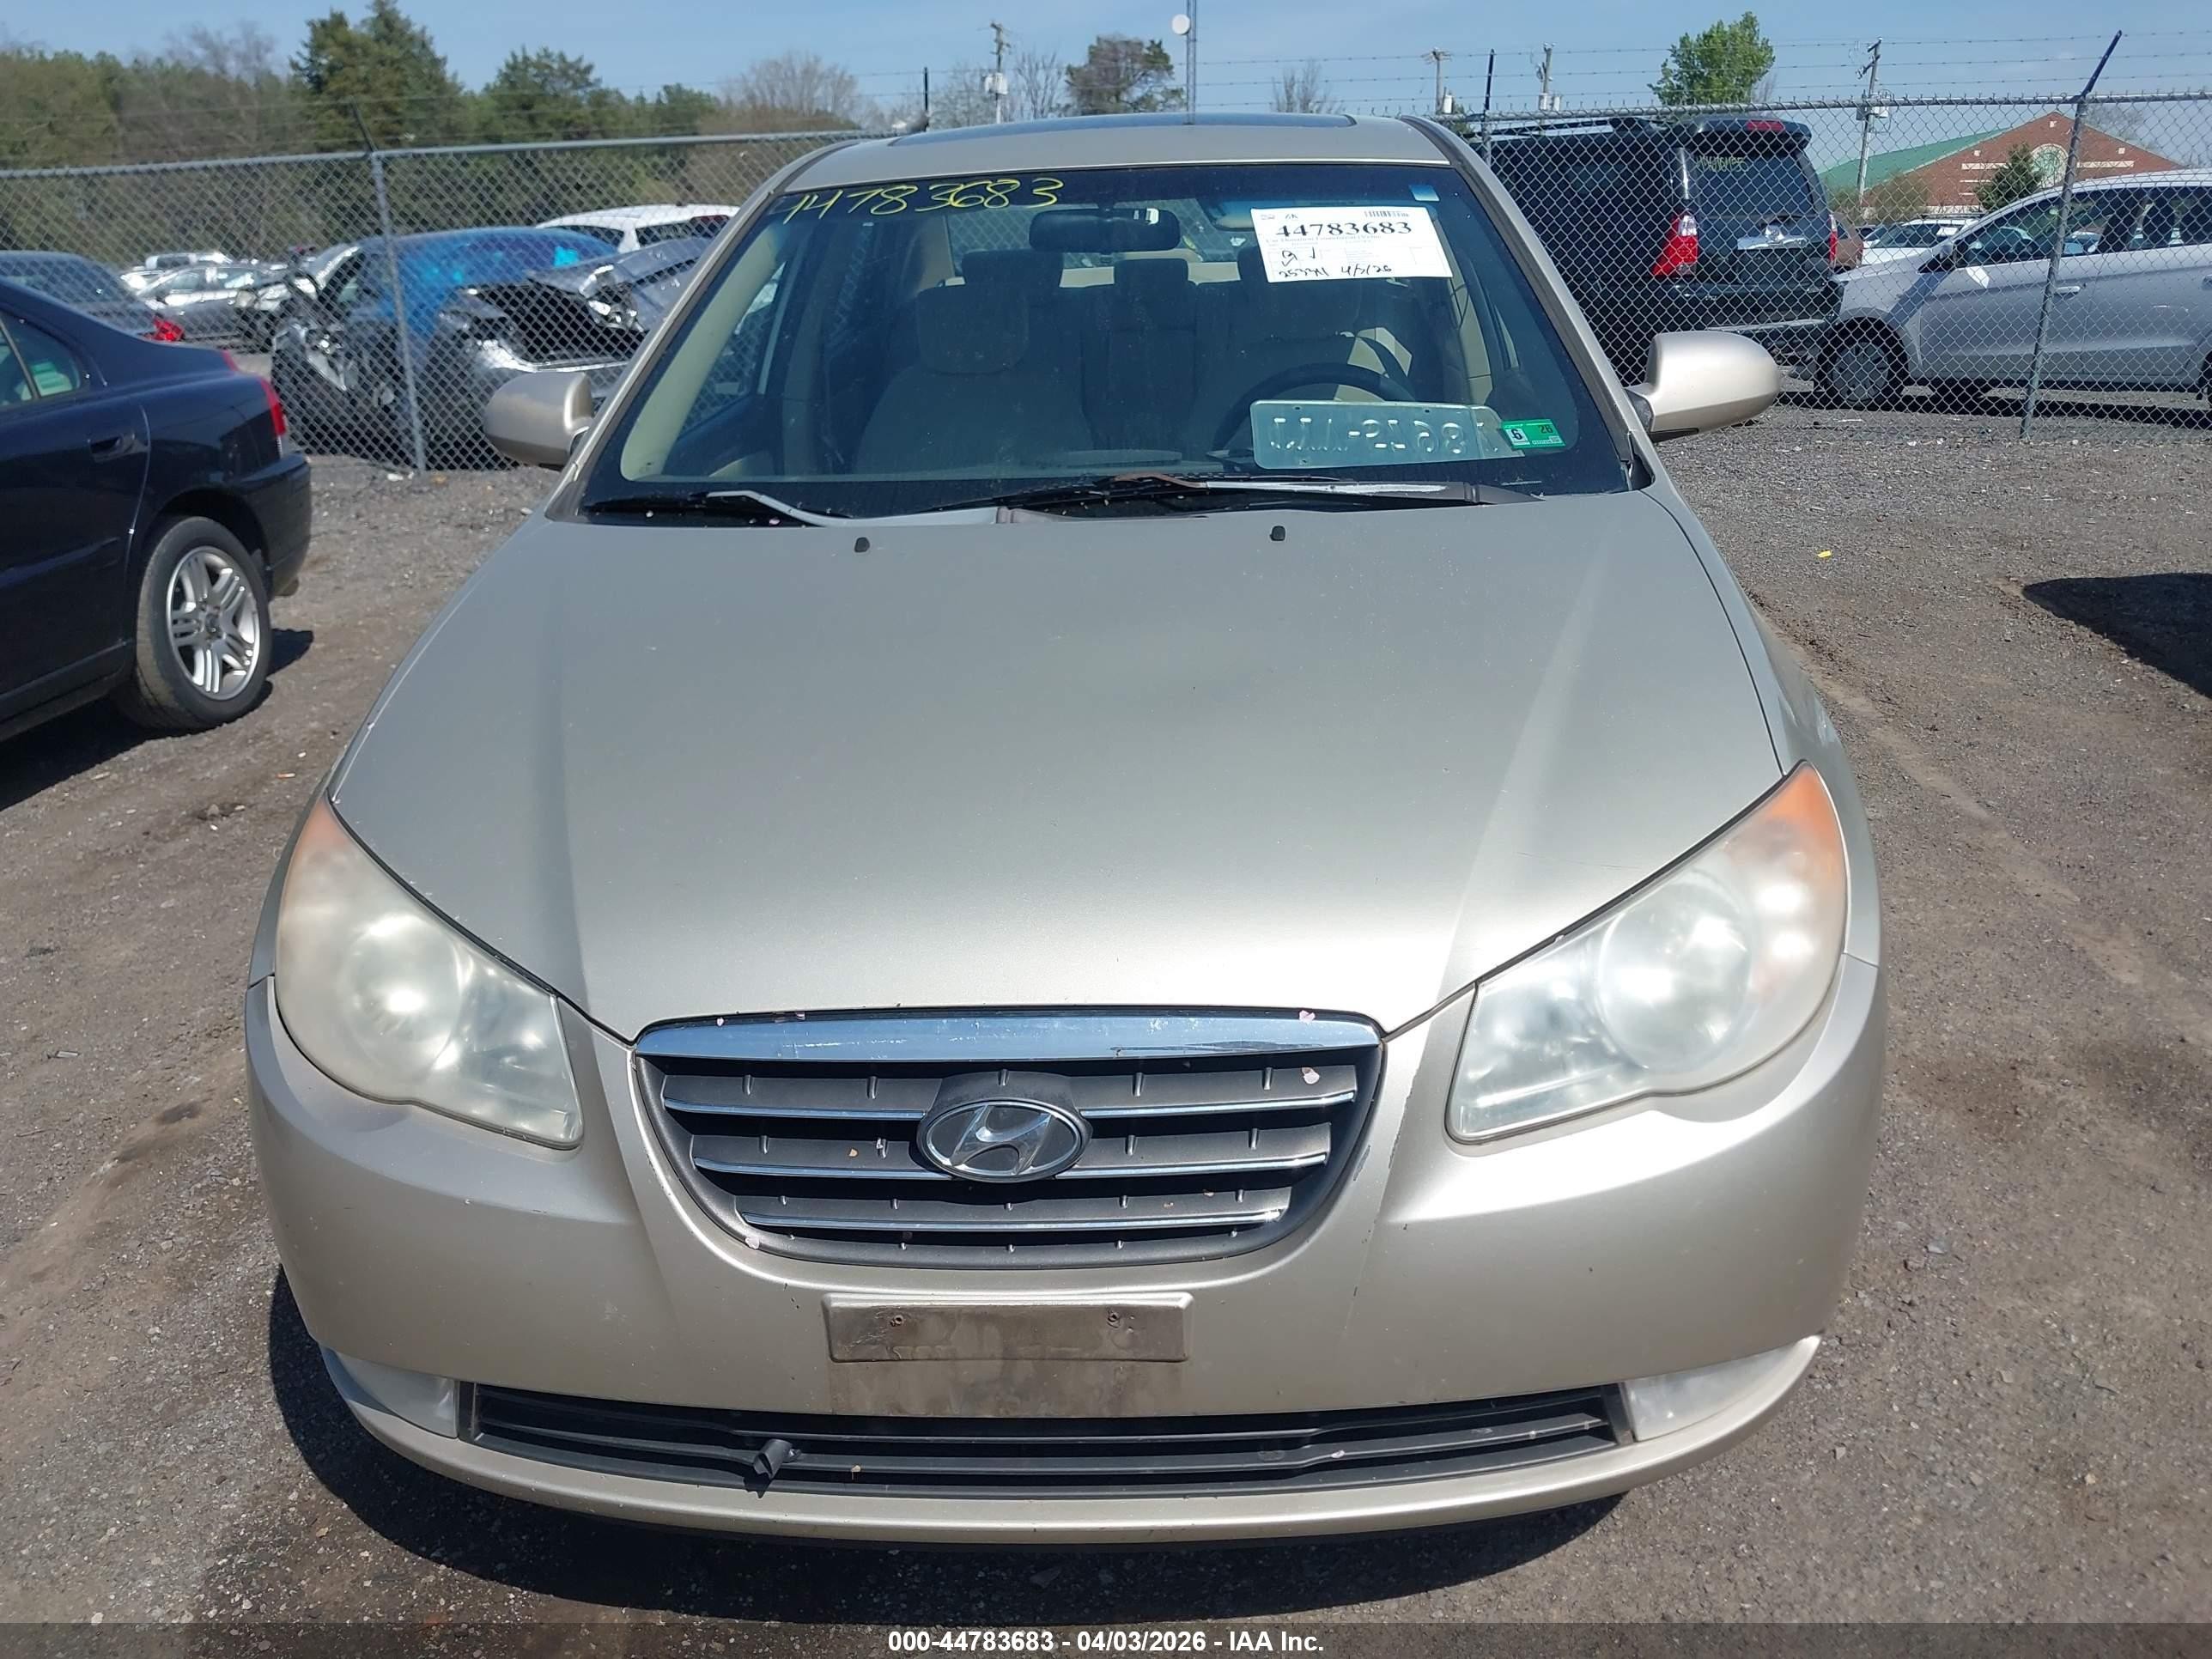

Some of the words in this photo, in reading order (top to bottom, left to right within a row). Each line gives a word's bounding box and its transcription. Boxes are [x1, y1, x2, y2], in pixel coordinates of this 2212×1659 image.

[1276, 222, 1413, 237] 44783683
[1510, 428, 1523, 441] 6
[1538, 424, 1553, 434] 26
